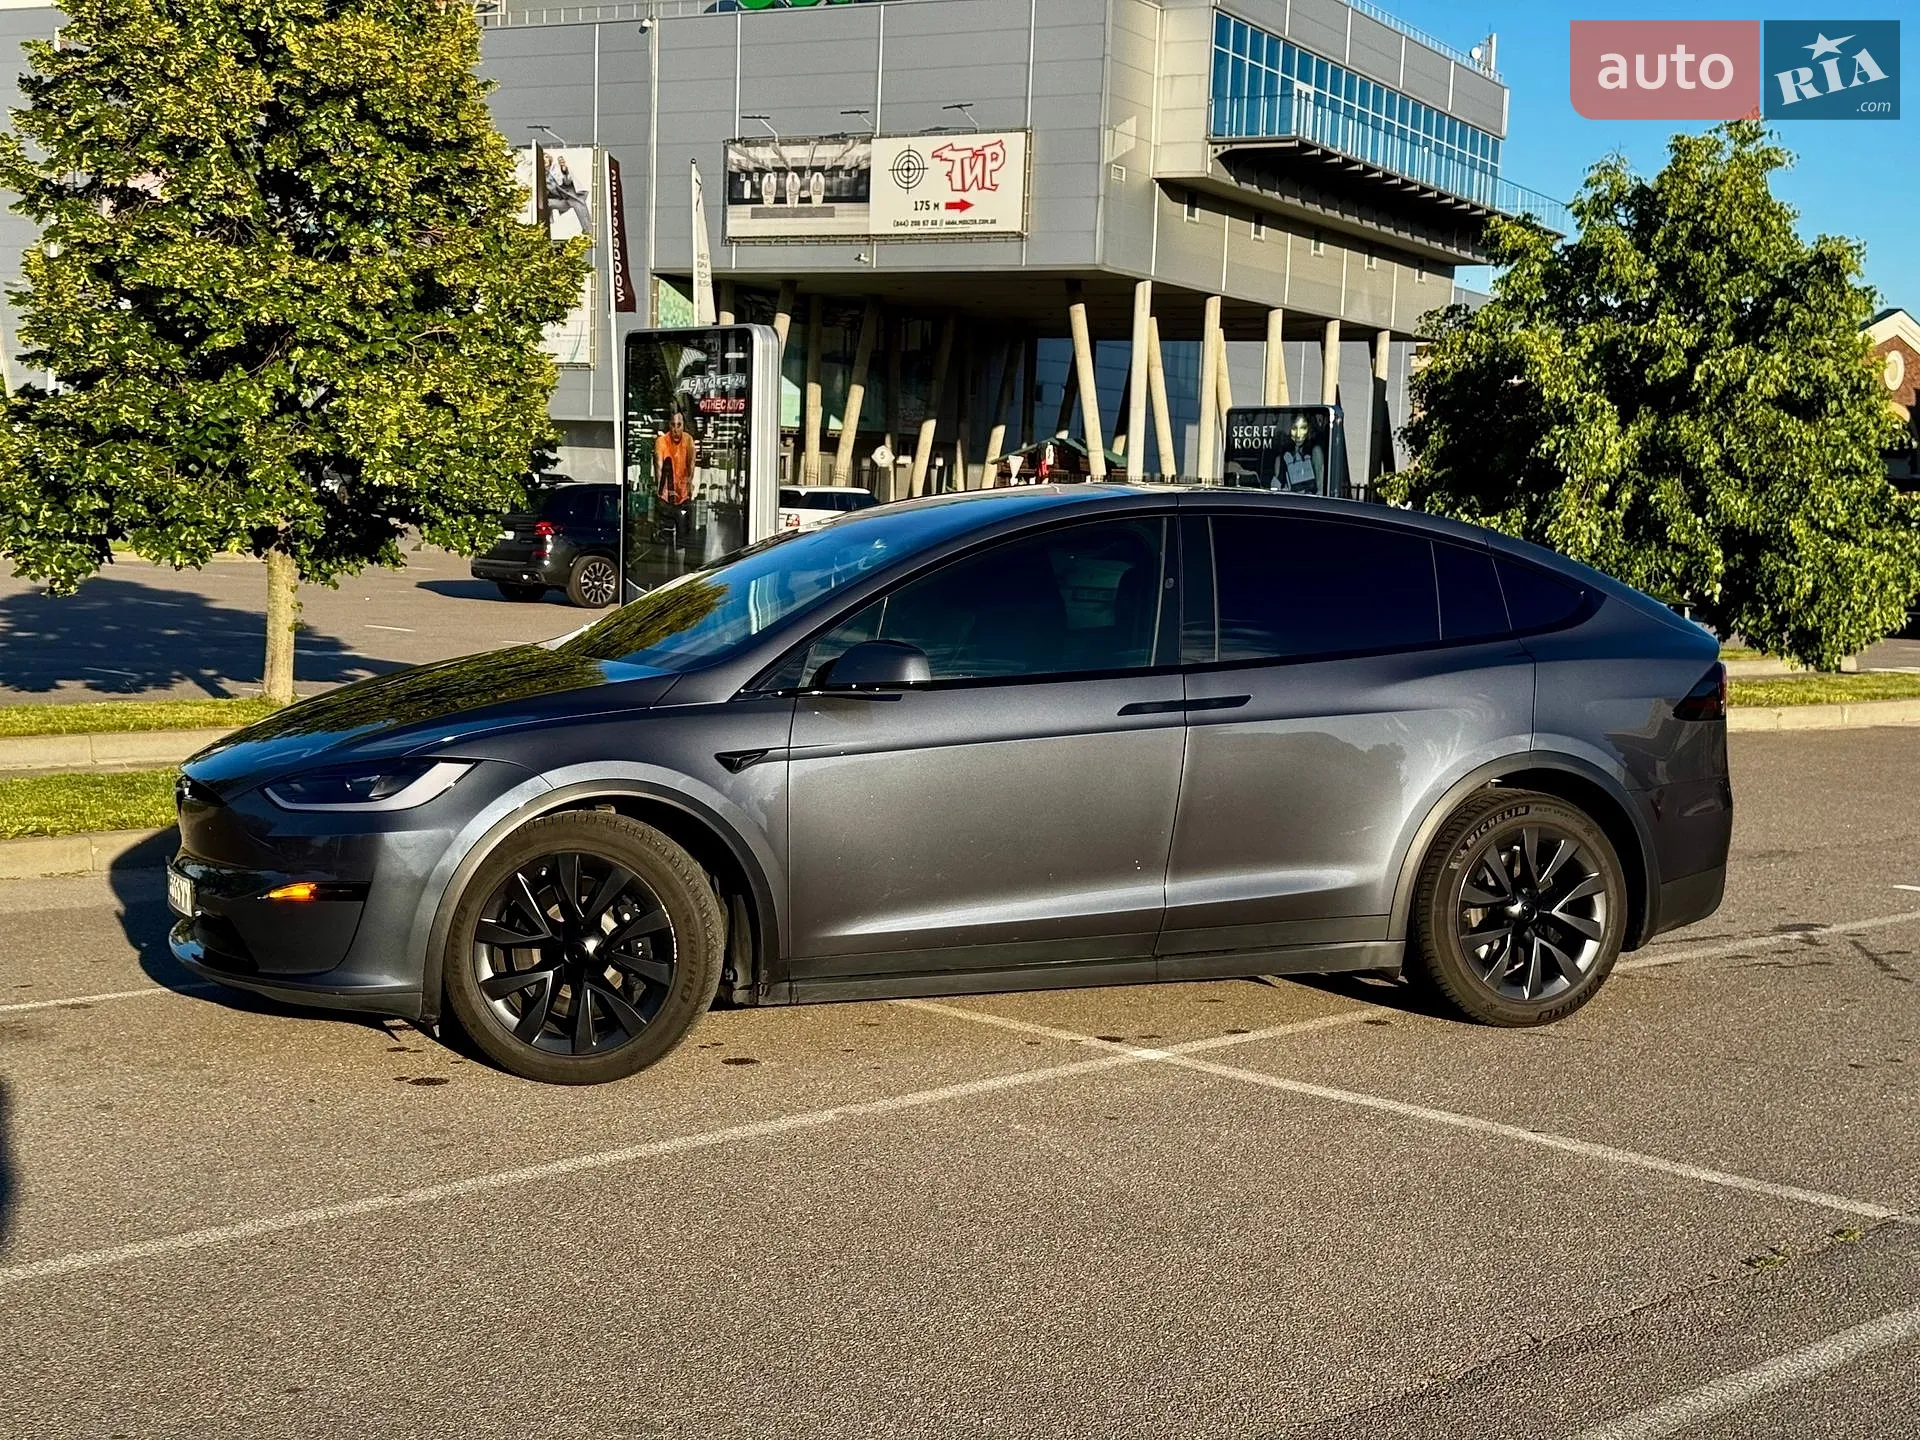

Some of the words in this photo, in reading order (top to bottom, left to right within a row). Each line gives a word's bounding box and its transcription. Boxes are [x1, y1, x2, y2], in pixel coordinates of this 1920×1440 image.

[931, 139, 1006, 192] ТИР
[914, 200, 930, 211] 175
[1232, 425, 1277, 438] SECRET
[1234, 438, 1272, 449] ROOM
[1466, 806, 1528, 848] MICHELIN
